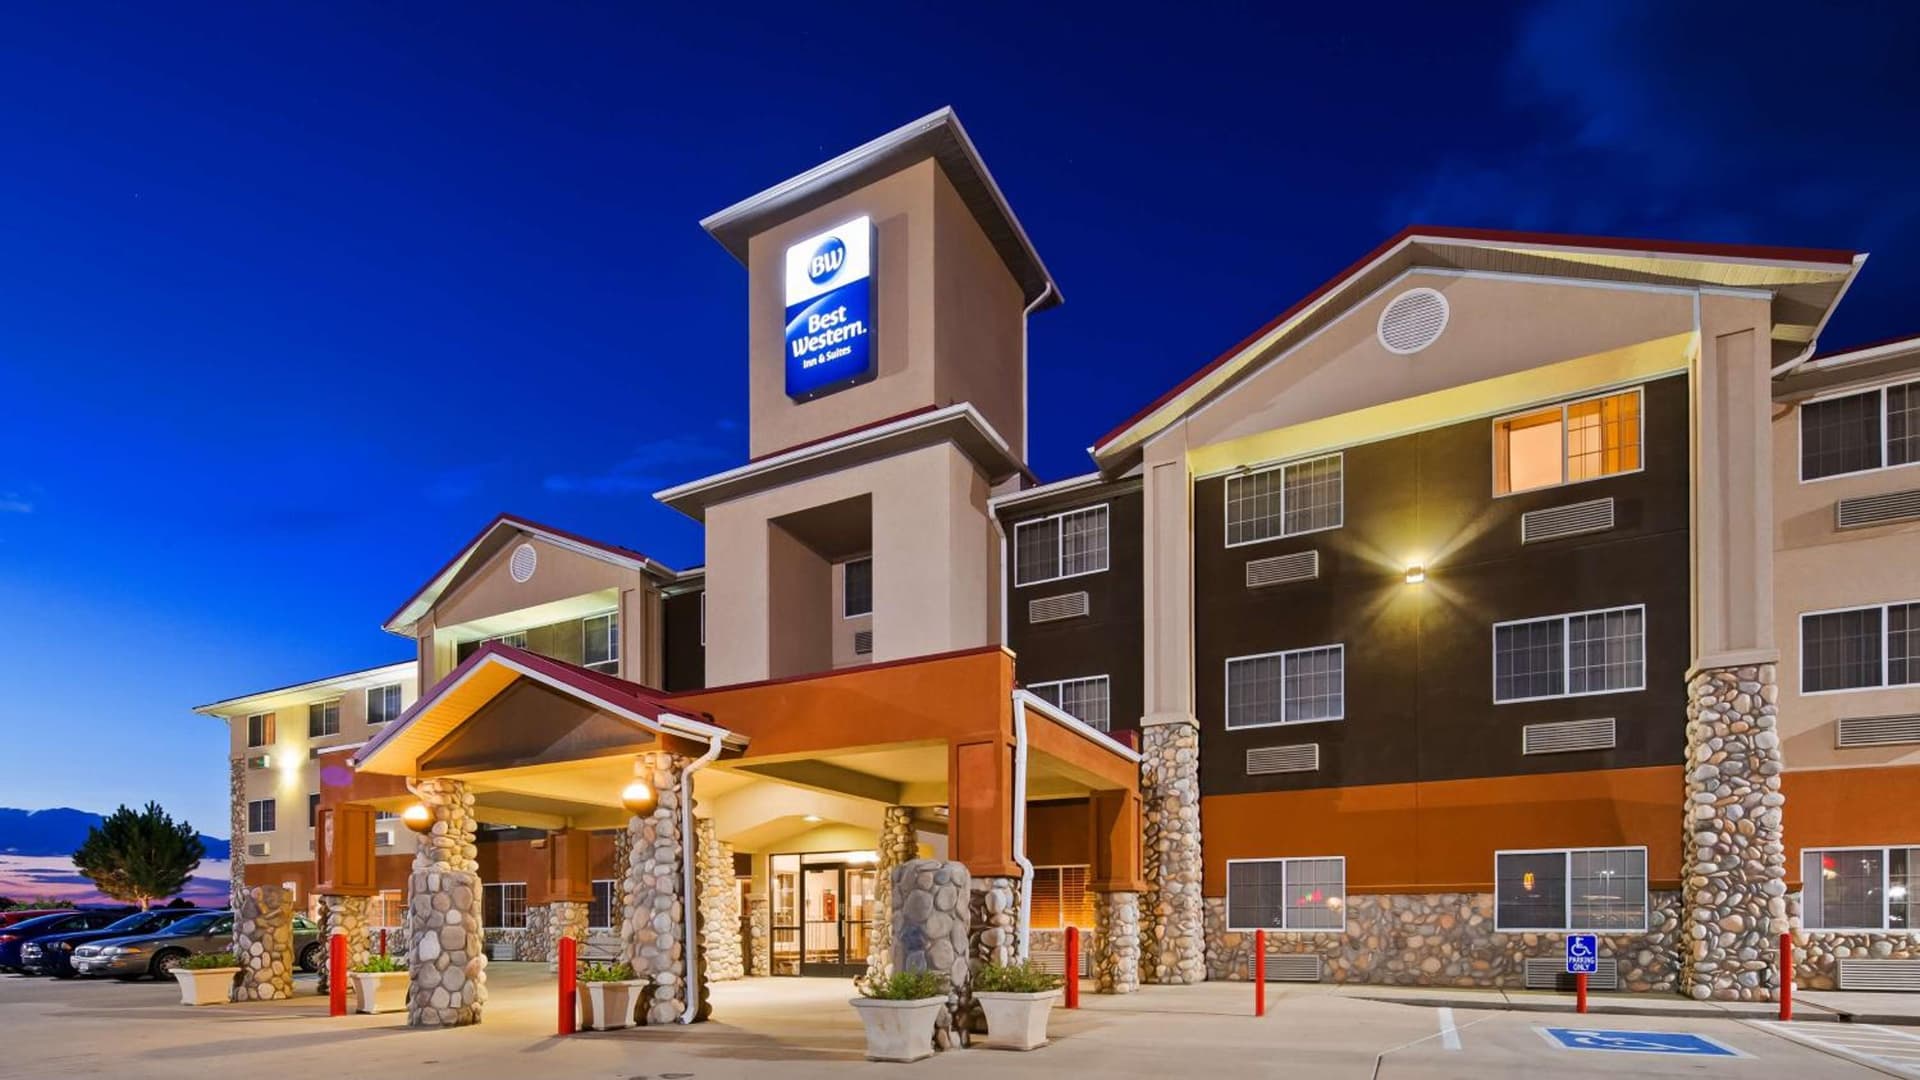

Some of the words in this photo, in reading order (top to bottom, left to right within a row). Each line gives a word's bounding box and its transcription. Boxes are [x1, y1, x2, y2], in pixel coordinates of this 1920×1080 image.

[811, 247, 843, 278] BW
[808, 305, 847, 334] Best
[803, 358, 817, 369] Inn
[818, 353, 826, 364] &
[826, 345, 852, 362] Suites
[1572, 963, 1590, 971] ONLY
